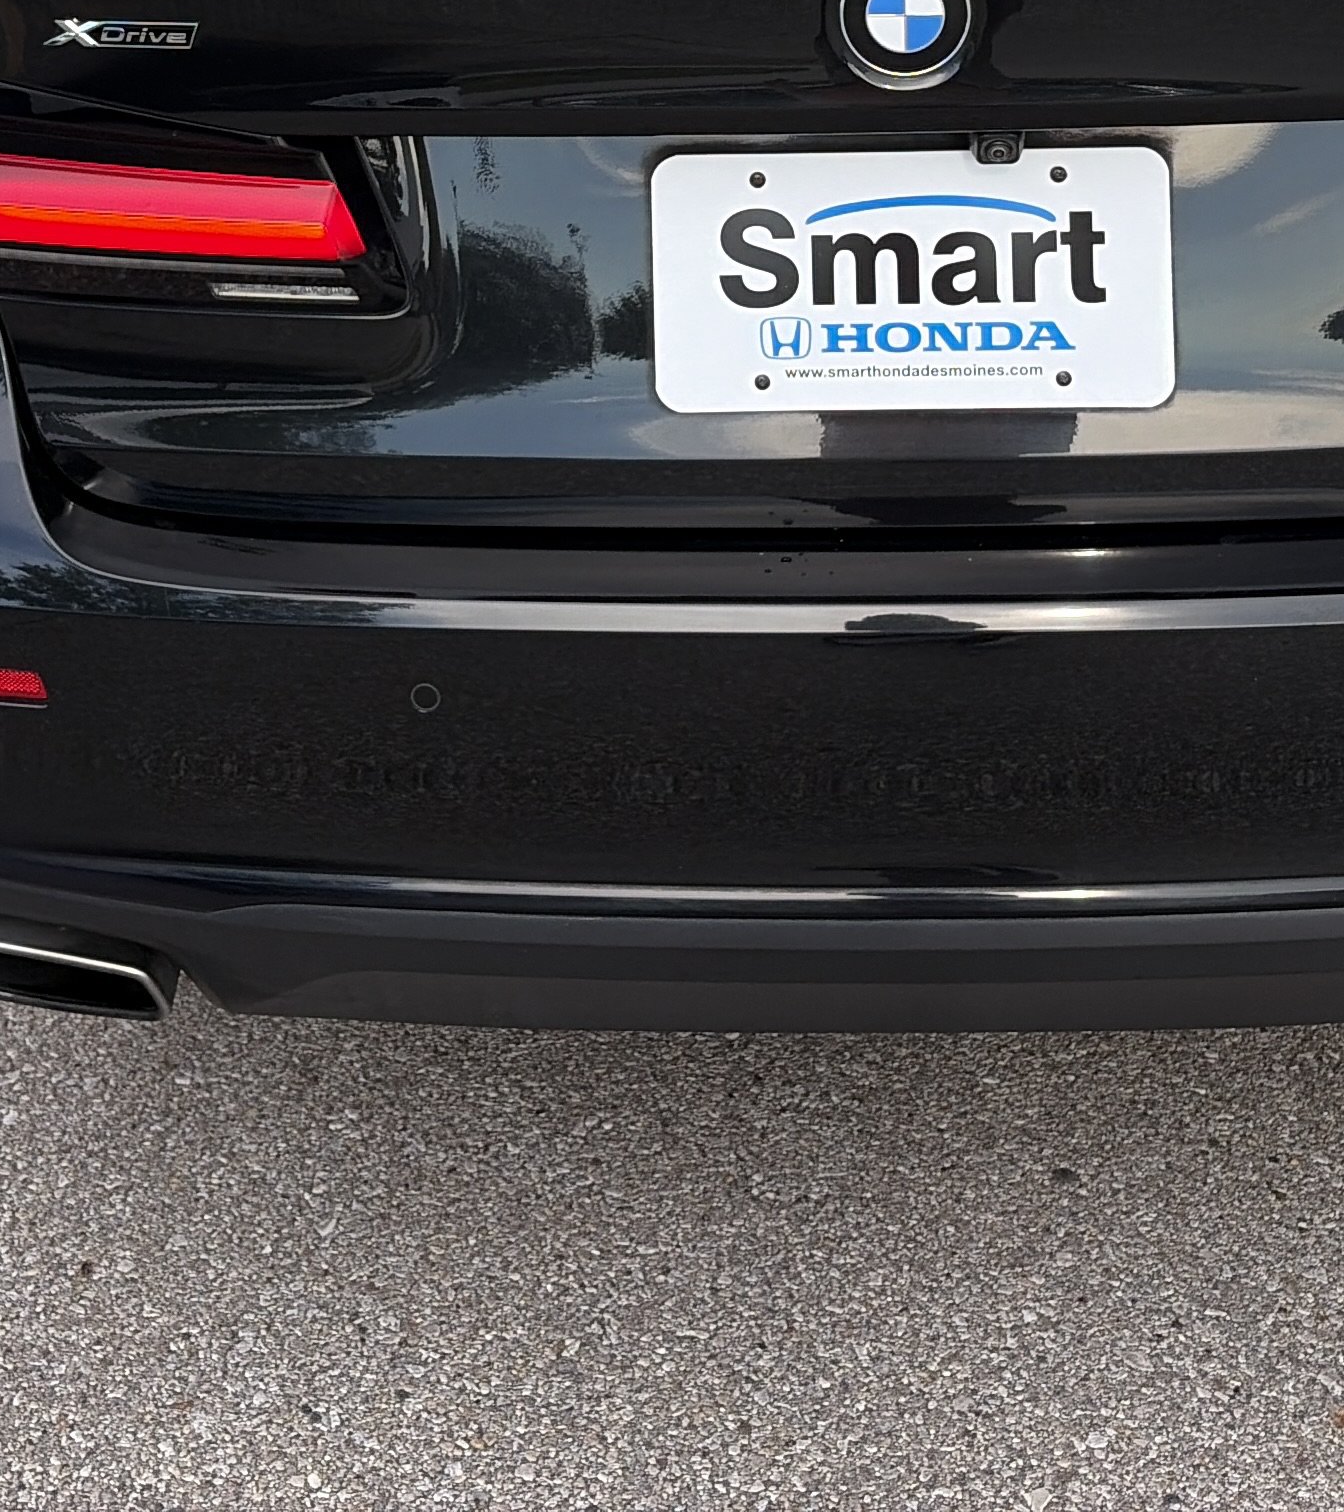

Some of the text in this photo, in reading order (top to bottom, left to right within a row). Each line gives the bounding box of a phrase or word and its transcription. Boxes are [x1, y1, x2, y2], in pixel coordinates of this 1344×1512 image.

[718, 207, 1107, 309] Smart
[820, 320, 1076, 353] HONDA
[785, 363, 1043, 379] www.smarthondadesmoines.com
